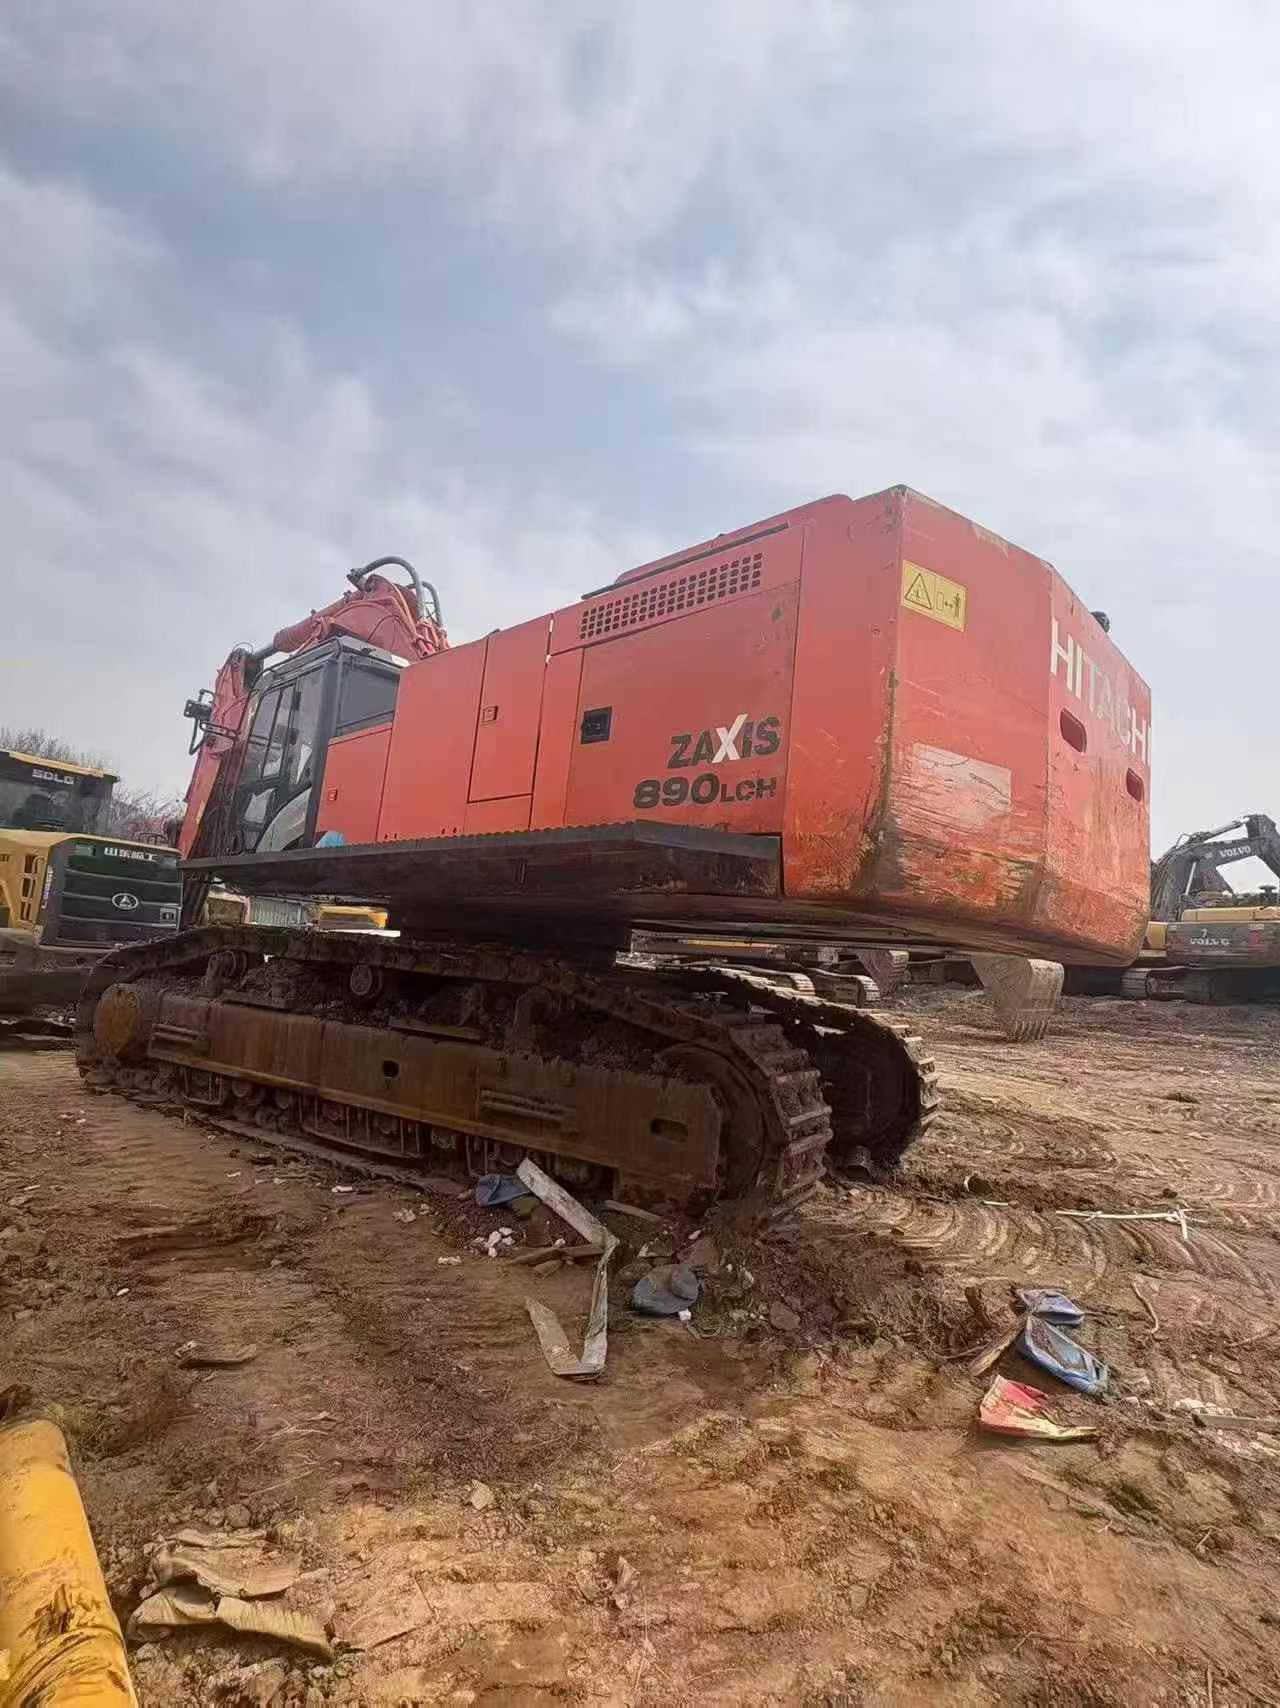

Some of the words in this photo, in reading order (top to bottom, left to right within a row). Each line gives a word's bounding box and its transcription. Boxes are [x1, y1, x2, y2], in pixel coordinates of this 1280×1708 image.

[667, 713, 781, 769] ZAXIS
[32, 769, 74, 785] SDLG
[1220, 846, 1252, 857] VOLVO
[1190, 937, 1230, 946] VOLVO
